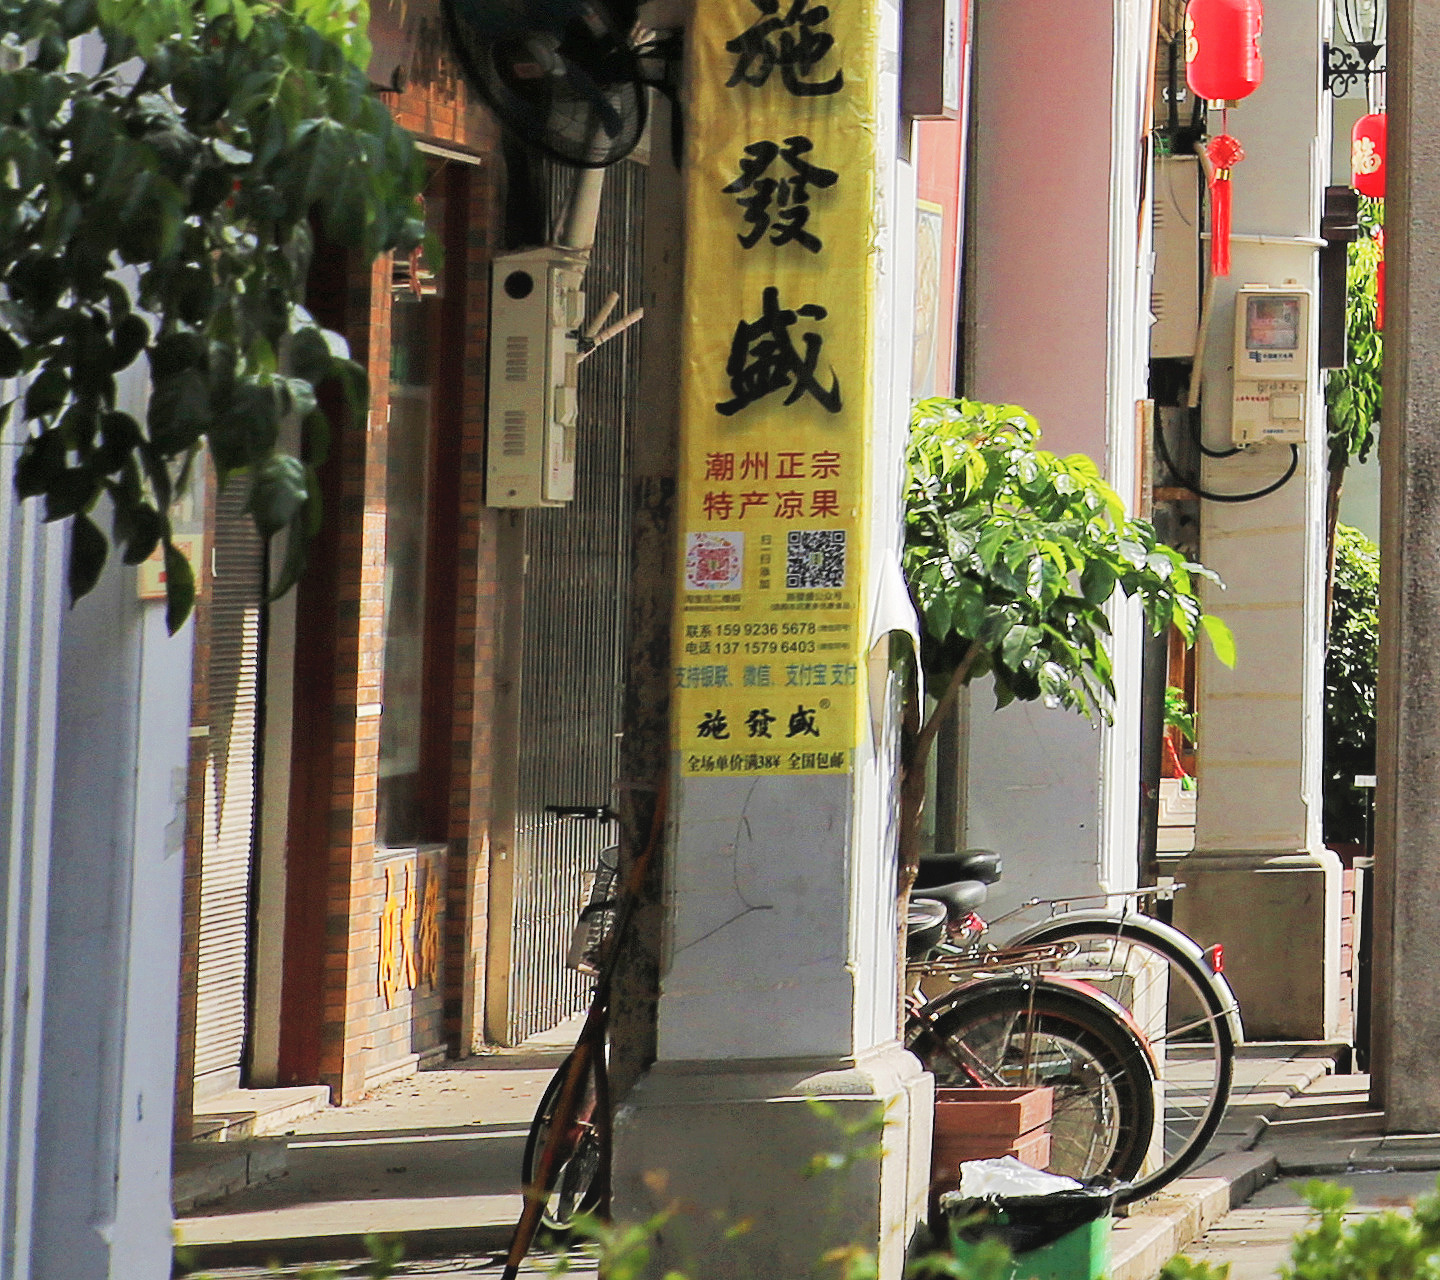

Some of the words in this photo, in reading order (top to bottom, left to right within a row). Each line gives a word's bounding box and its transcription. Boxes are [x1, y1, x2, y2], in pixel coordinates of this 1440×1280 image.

[705, 451, 841, 481] 潮州正宗
[703, 489, 840, 521] 特产凉果
[685, 624, 712, 638] 联系
[716, 624, 741, 636] 159
[744, 624, 778, 636] 9236
[782, 623, 816, 635] 5678
[685, 641, 711, 655] 电话
[716, 642, 739, 654] 137
[744, 642, 778, 654] 1579
[781, 640, 816, 653] 6403
